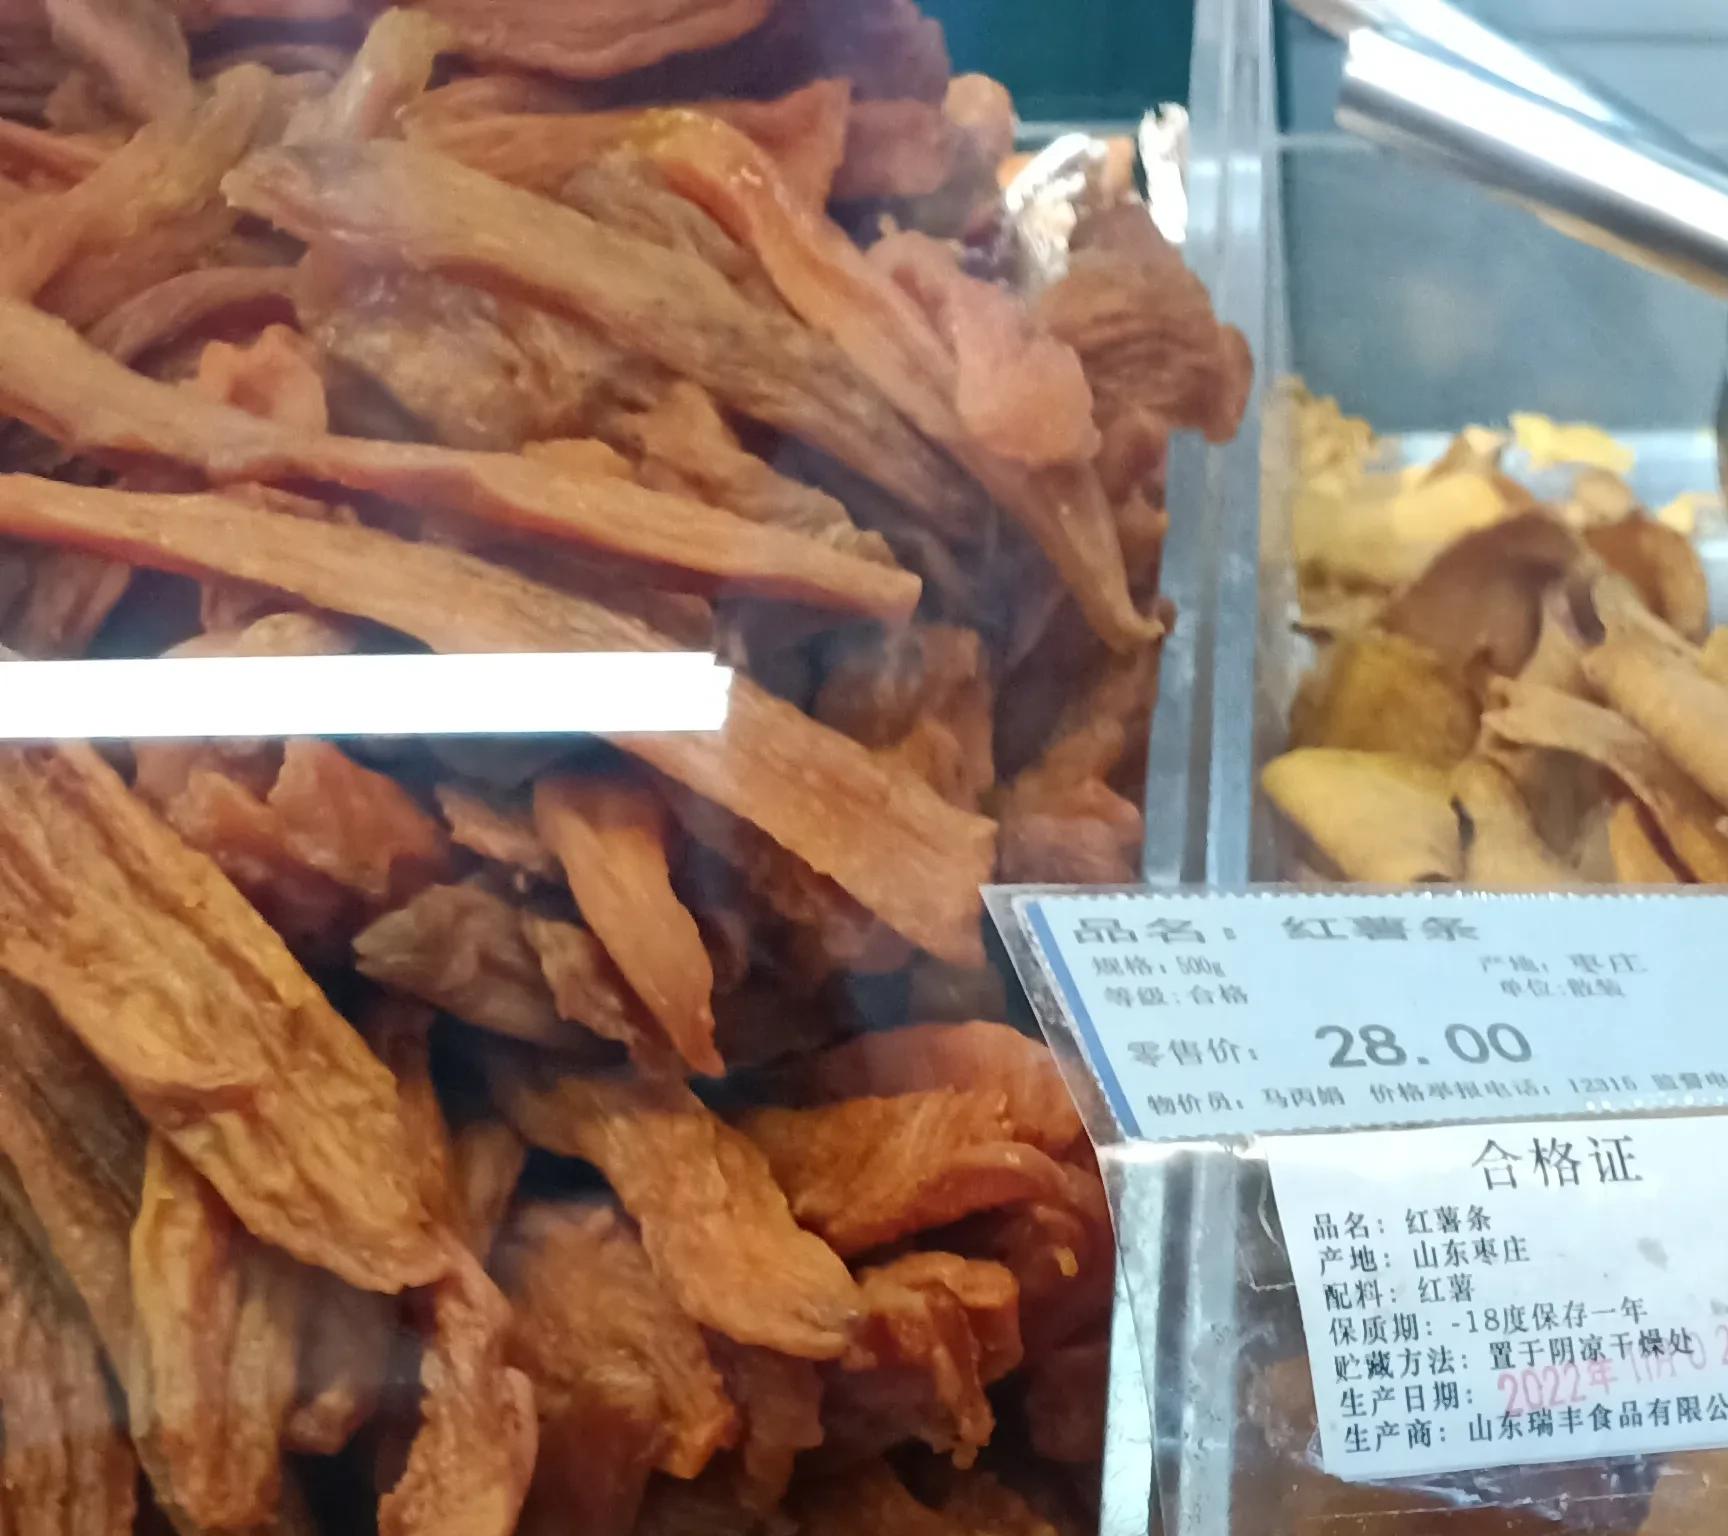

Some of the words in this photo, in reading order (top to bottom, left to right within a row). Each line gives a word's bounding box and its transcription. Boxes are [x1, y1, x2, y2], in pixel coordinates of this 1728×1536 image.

[1314, 1023, 1533, 1069] 28.00
[1471, 1134, 1644, 1191] 合格证
